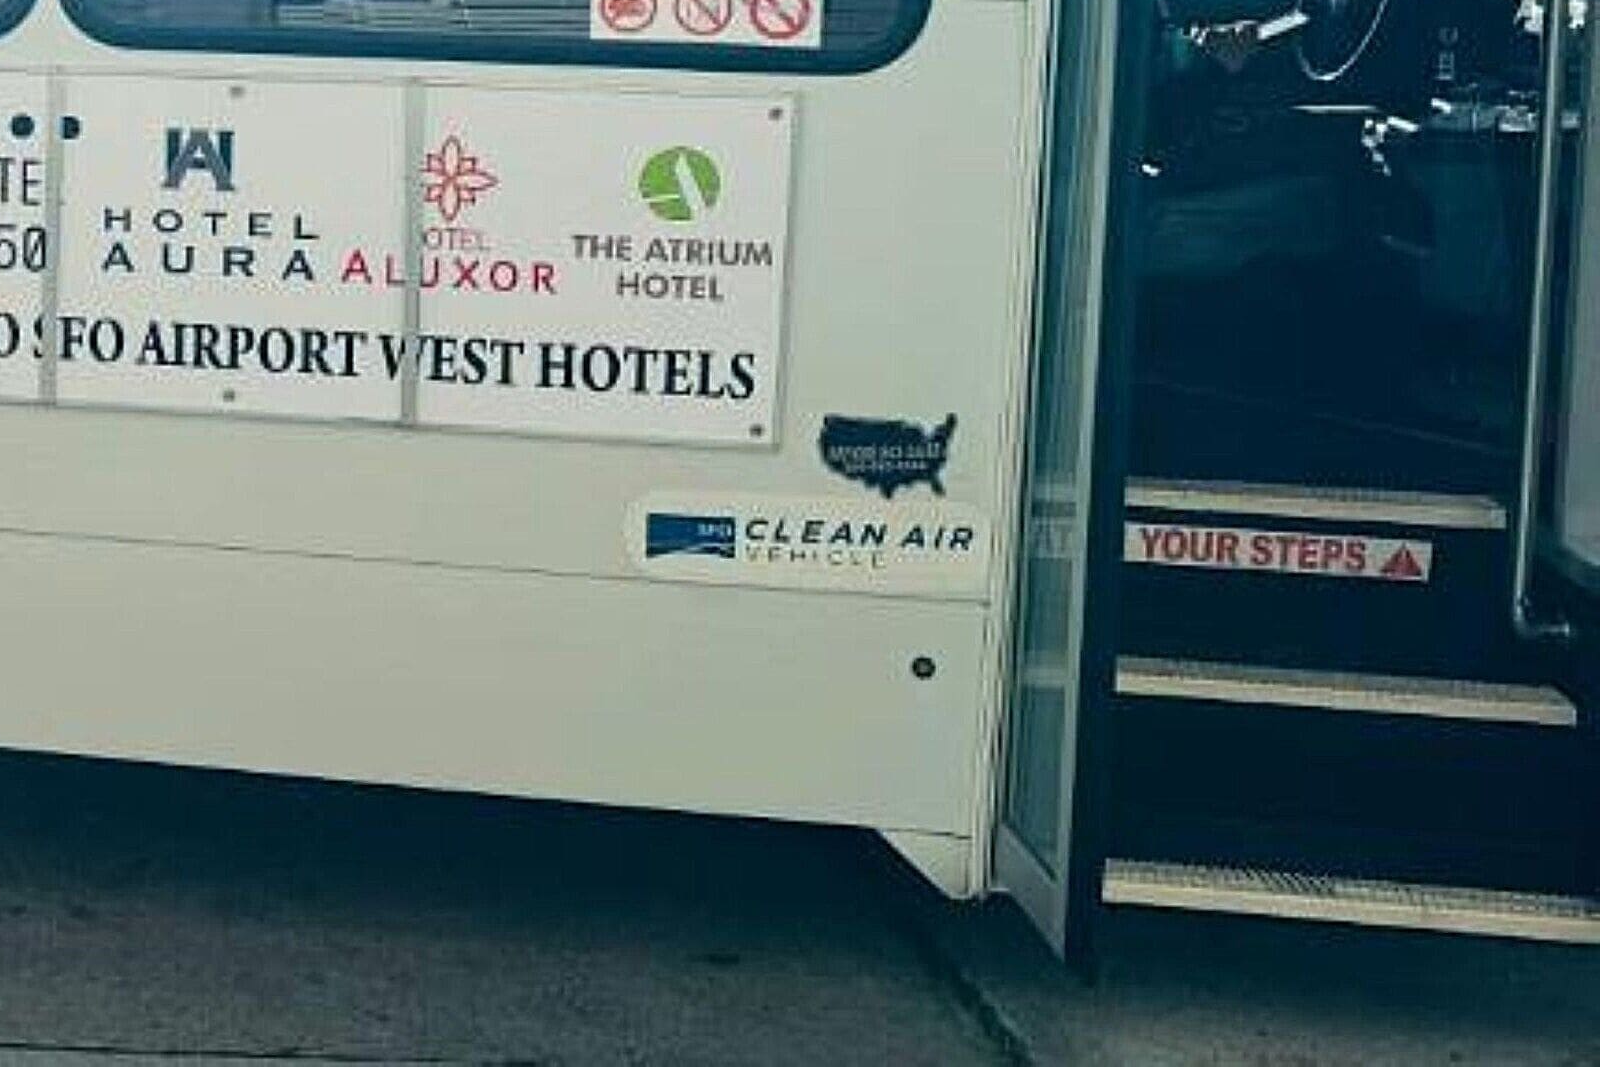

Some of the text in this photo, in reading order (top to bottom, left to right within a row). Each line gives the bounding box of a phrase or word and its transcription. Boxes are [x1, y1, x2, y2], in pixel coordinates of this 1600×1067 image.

[104, 208, 320, 240] HOTEL
[422, 228, 493, 252] OTEL
[102, 242, 315, 281] AURA
[572, 234, 773, 267] THE ATRIUM
[341, 249, 557, 293] ALUXOR
[616, 272, 725, 302] HOTEL
[136, 318, 369, 376] AIRPORT
[378, 334, 525, 386] WEST
[534, 342, 756, 400] HOTELS
[745, 519, 888, 546] CLEAN
[900, 525, 975, 552] AIR
[1140, 529, 1367, 573] YOUR STEPS
